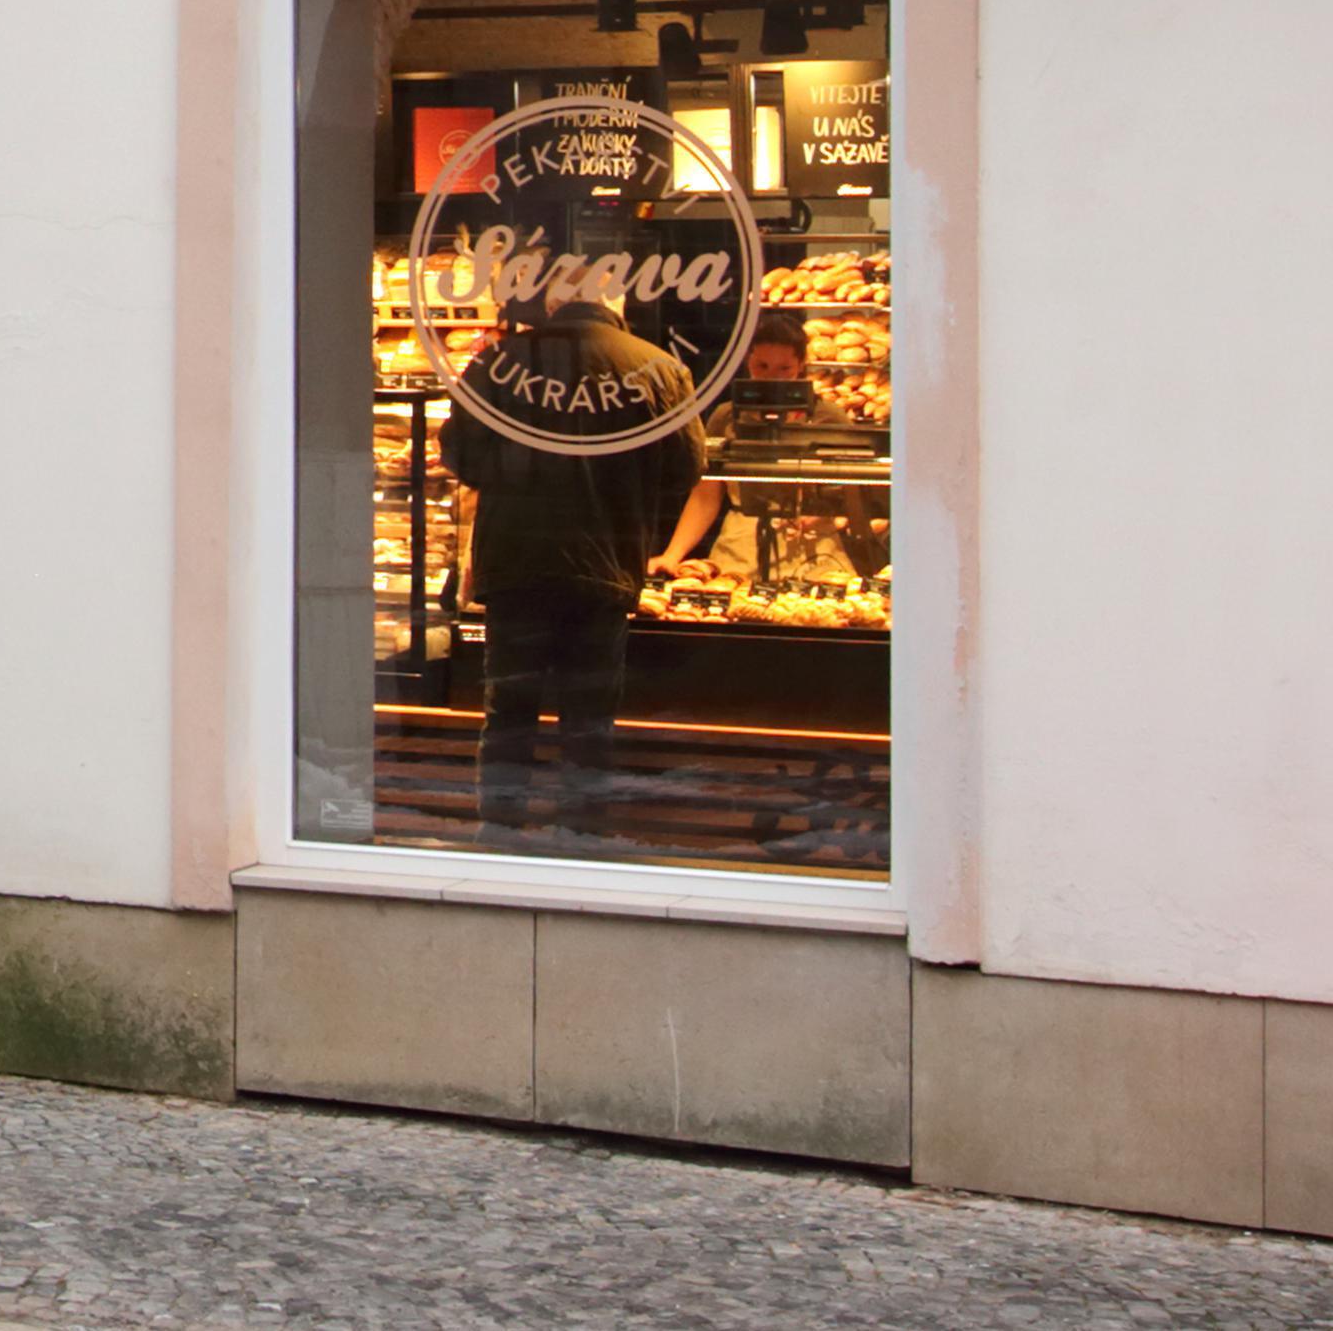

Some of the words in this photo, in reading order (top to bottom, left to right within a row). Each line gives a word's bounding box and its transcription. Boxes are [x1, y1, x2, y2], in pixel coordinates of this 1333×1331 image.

[813, 116, 829, 137] U
[832, 110, 875, 138] NÁS
[802, 142, 816, 165] V
[819, 134, 890, 165] SÁZAVĚ
[438, 225, 733, 303] Sázava
